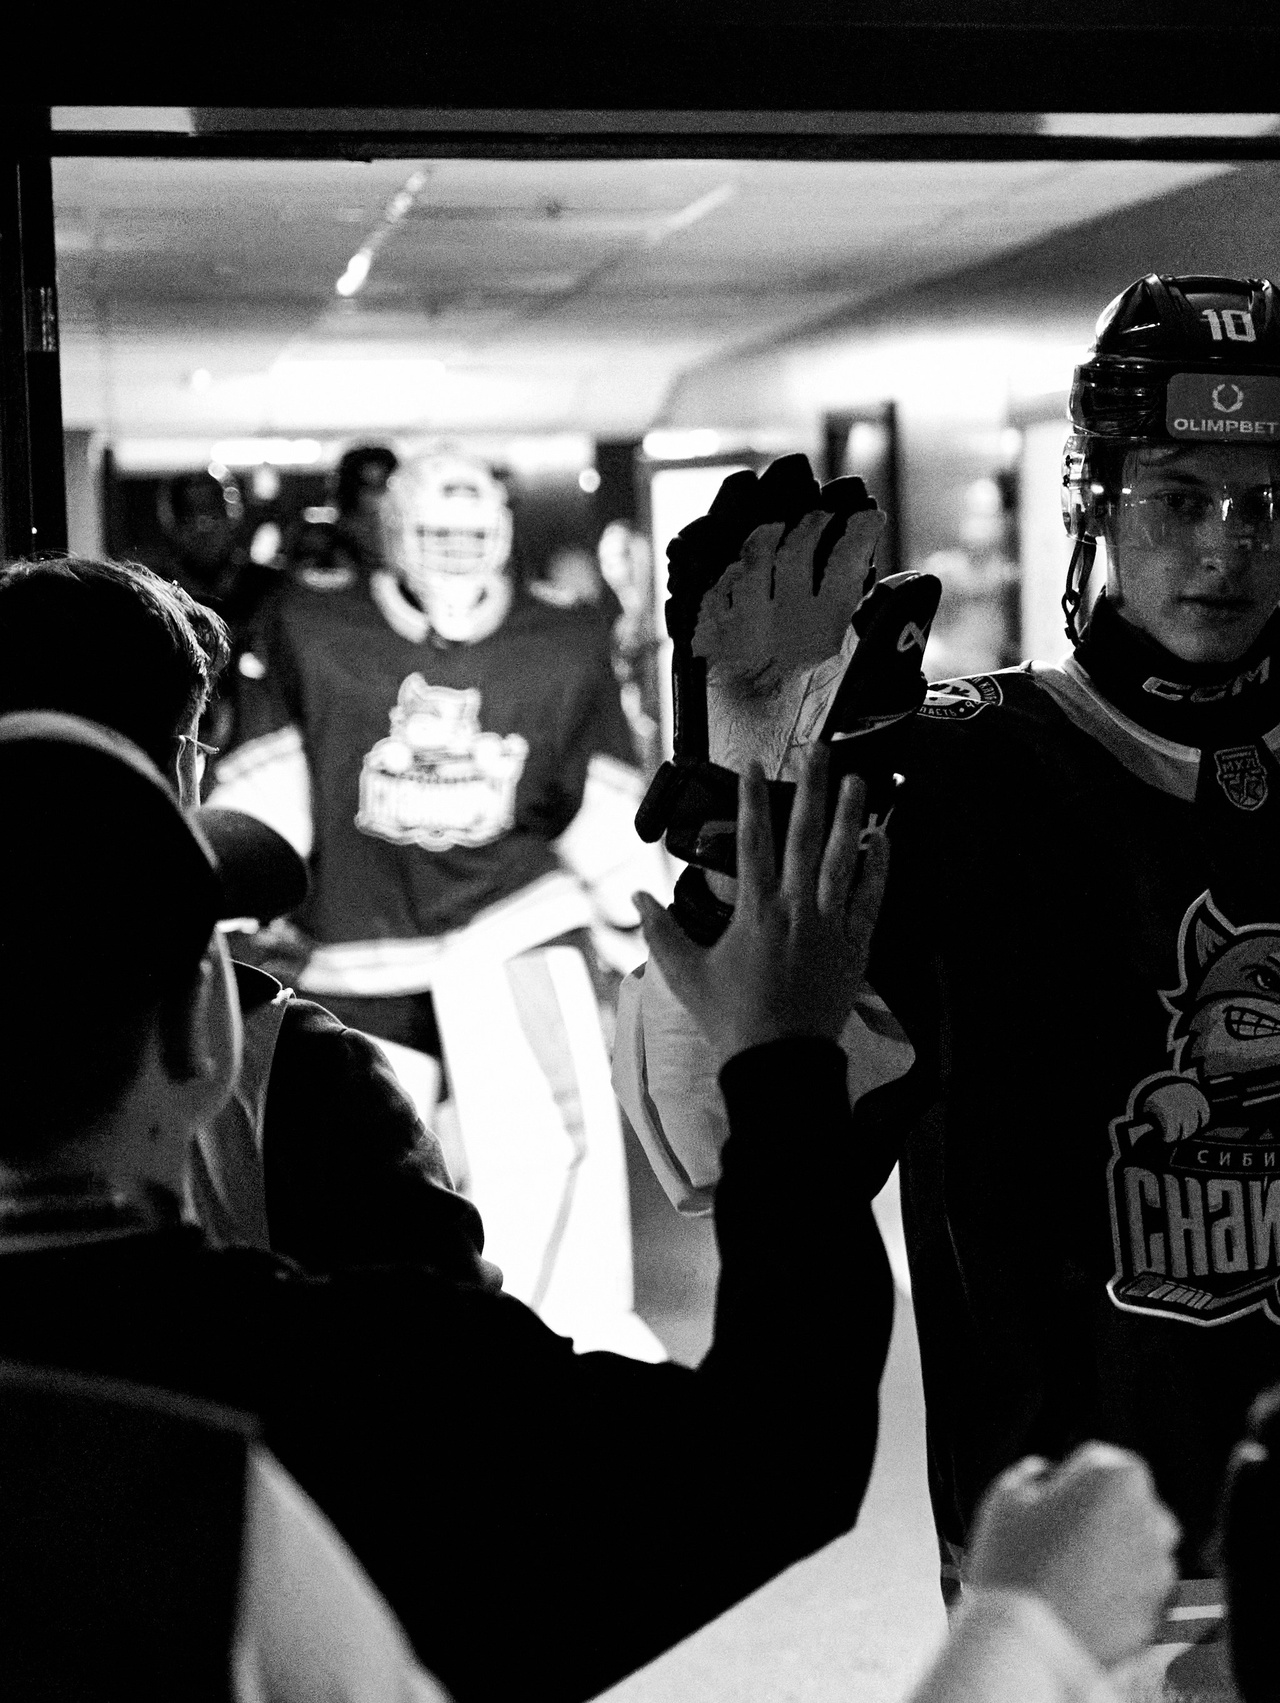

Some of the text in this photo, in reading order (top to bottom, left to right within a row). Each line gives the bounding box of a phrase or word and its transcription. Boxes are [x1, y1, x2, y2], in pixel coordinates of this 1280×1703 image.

[1200, 309, 1257, 342] 10
[1173, 417, 1279, 434] OLIMPBET
[1142, 656, 1271, 702] CCM
[919, 705, 958, 717] ЛАСТЬ
